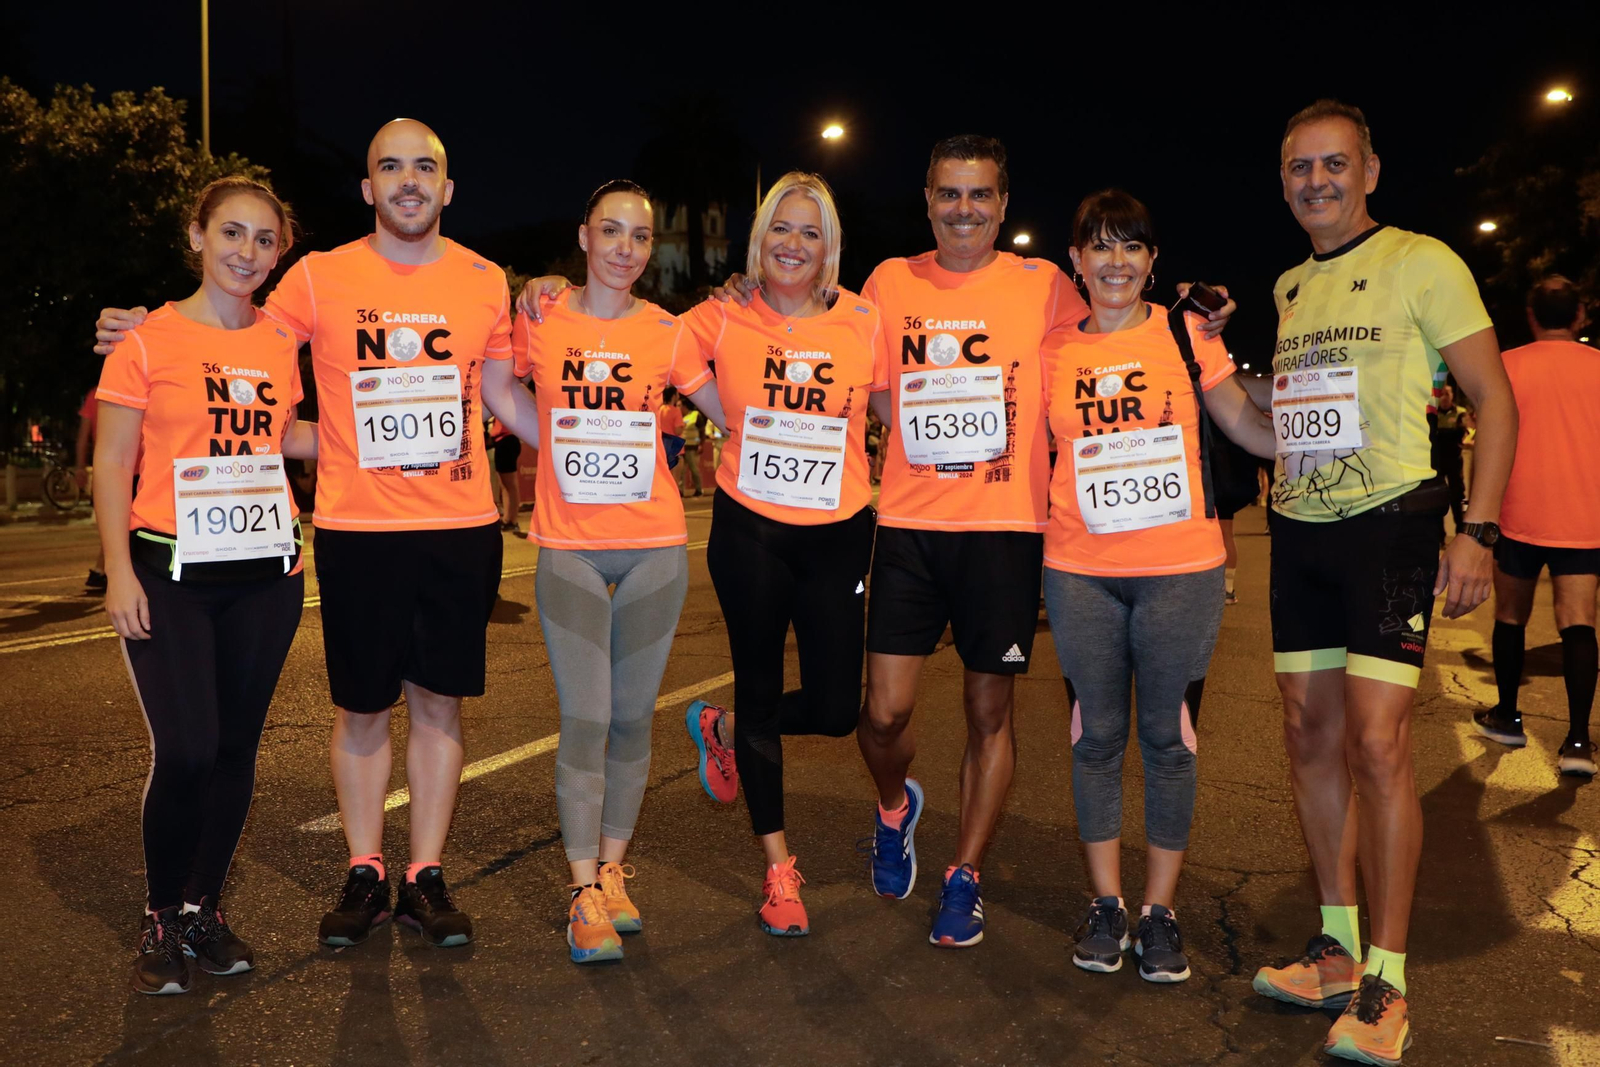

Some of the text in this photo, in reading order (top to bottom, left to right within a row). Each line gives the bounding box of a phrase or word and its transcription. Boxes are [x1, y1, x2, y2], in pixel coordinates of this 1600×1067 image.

[356, 309, 447, 324] 36 CARRERA
[904, 316, 986, 330] 36 CARRERA
[1302, 325, 1382, 348] PIRÁMIDE
[566, 347, 630, 360] 36 CARRERA
[767, 345, 832, 360] 36 CARRERA
[202, 363, 269, 379] 36 CARRERA
[1076, 361, 1142, 377] 36 CARRERA
[562, 386, 626, 410] TUR
[763, 383, 826, 412] TUR
[1076, 396, 1145, 426] TUR
[208, 407, 272, 437] TUR
[364, 411, 456, 442] 19016
[909, 411, 998, 441] 15380
[1280, 408, 1341, 440] 3089
[210, 438, 253, 457] NA
[565, 451, 638, 479] 6823
[750, 451, 836, 485] 15377
[1086, 472, 1181, 509] 15386
[187, 503, 280, 536] 19021
